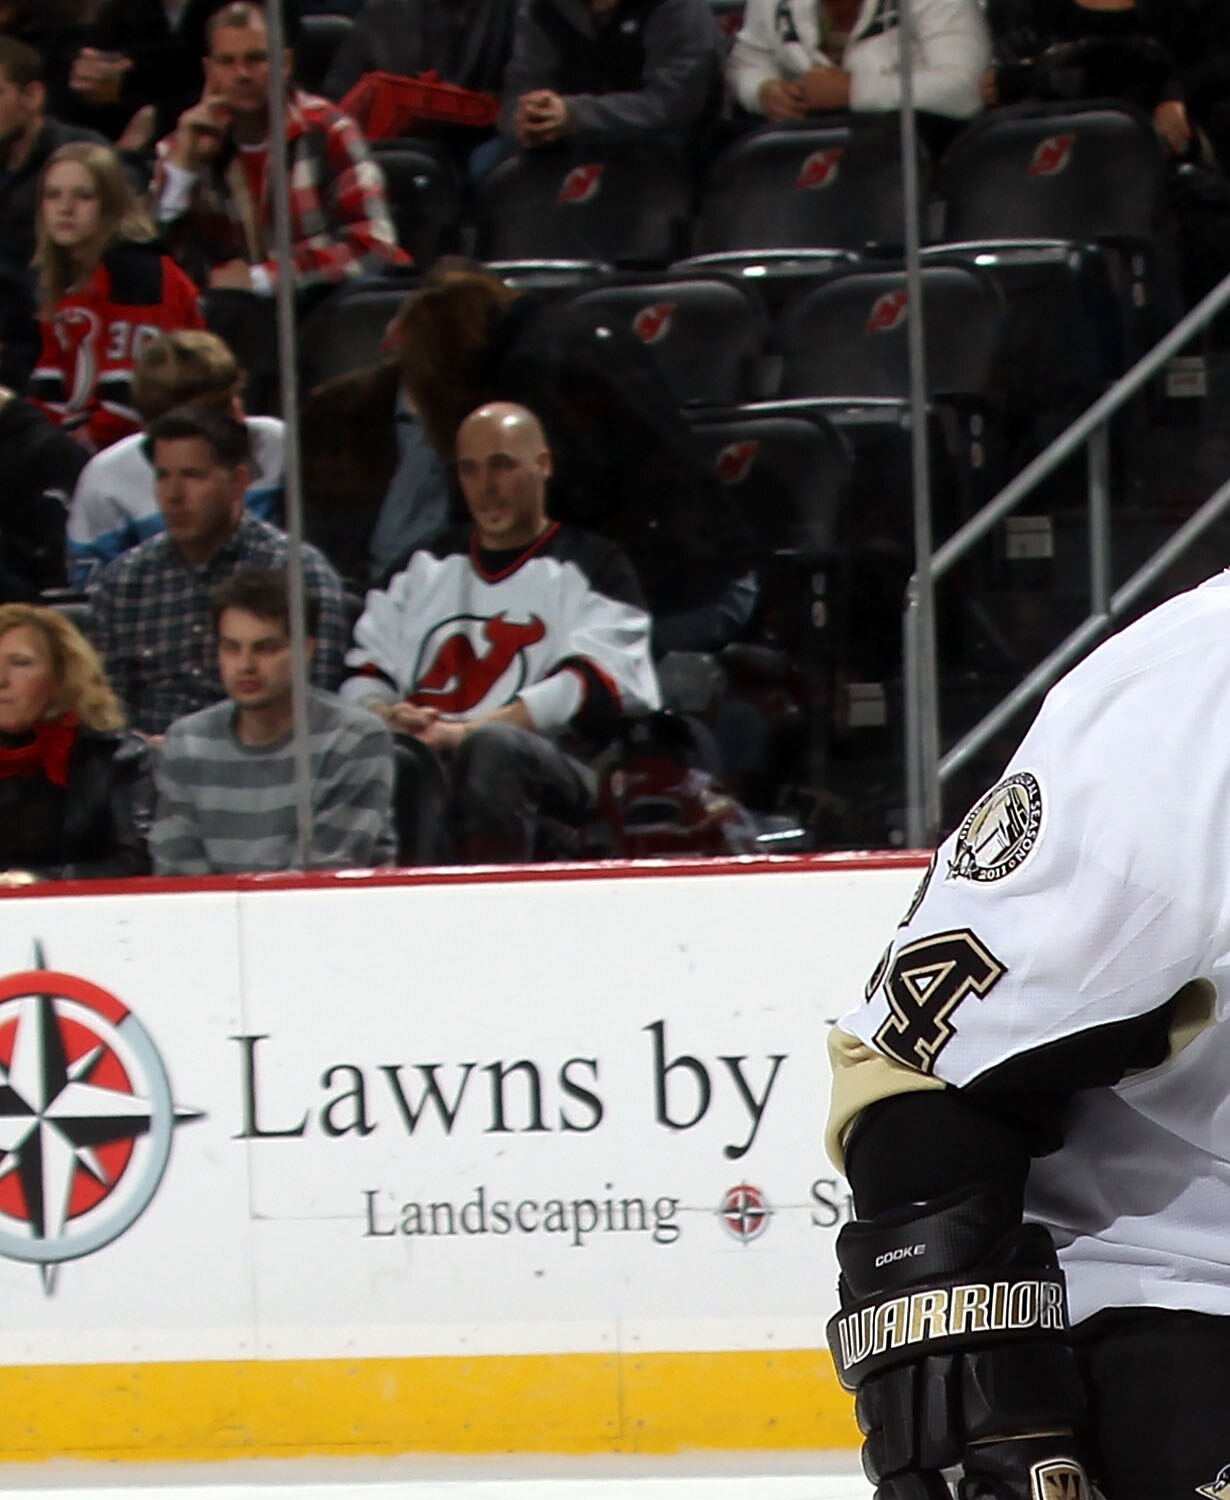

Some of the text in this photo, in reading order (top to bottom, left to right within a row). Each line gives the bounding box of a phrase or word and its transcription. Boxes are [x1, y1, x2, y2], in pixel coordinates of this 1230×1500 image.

[1013, 799, 1041, 863] SEASON
[978, 863, 1008, 880] 2011
[866, 850, 1008, 1076] 4
[229, 1019, 788, 1160] Lawns by
[362, 1183, 680, 1246] Landscaping
[875, 1244, 926, 1267] COOKE
[838, 1281, 1064, 1370] WARRIOR
